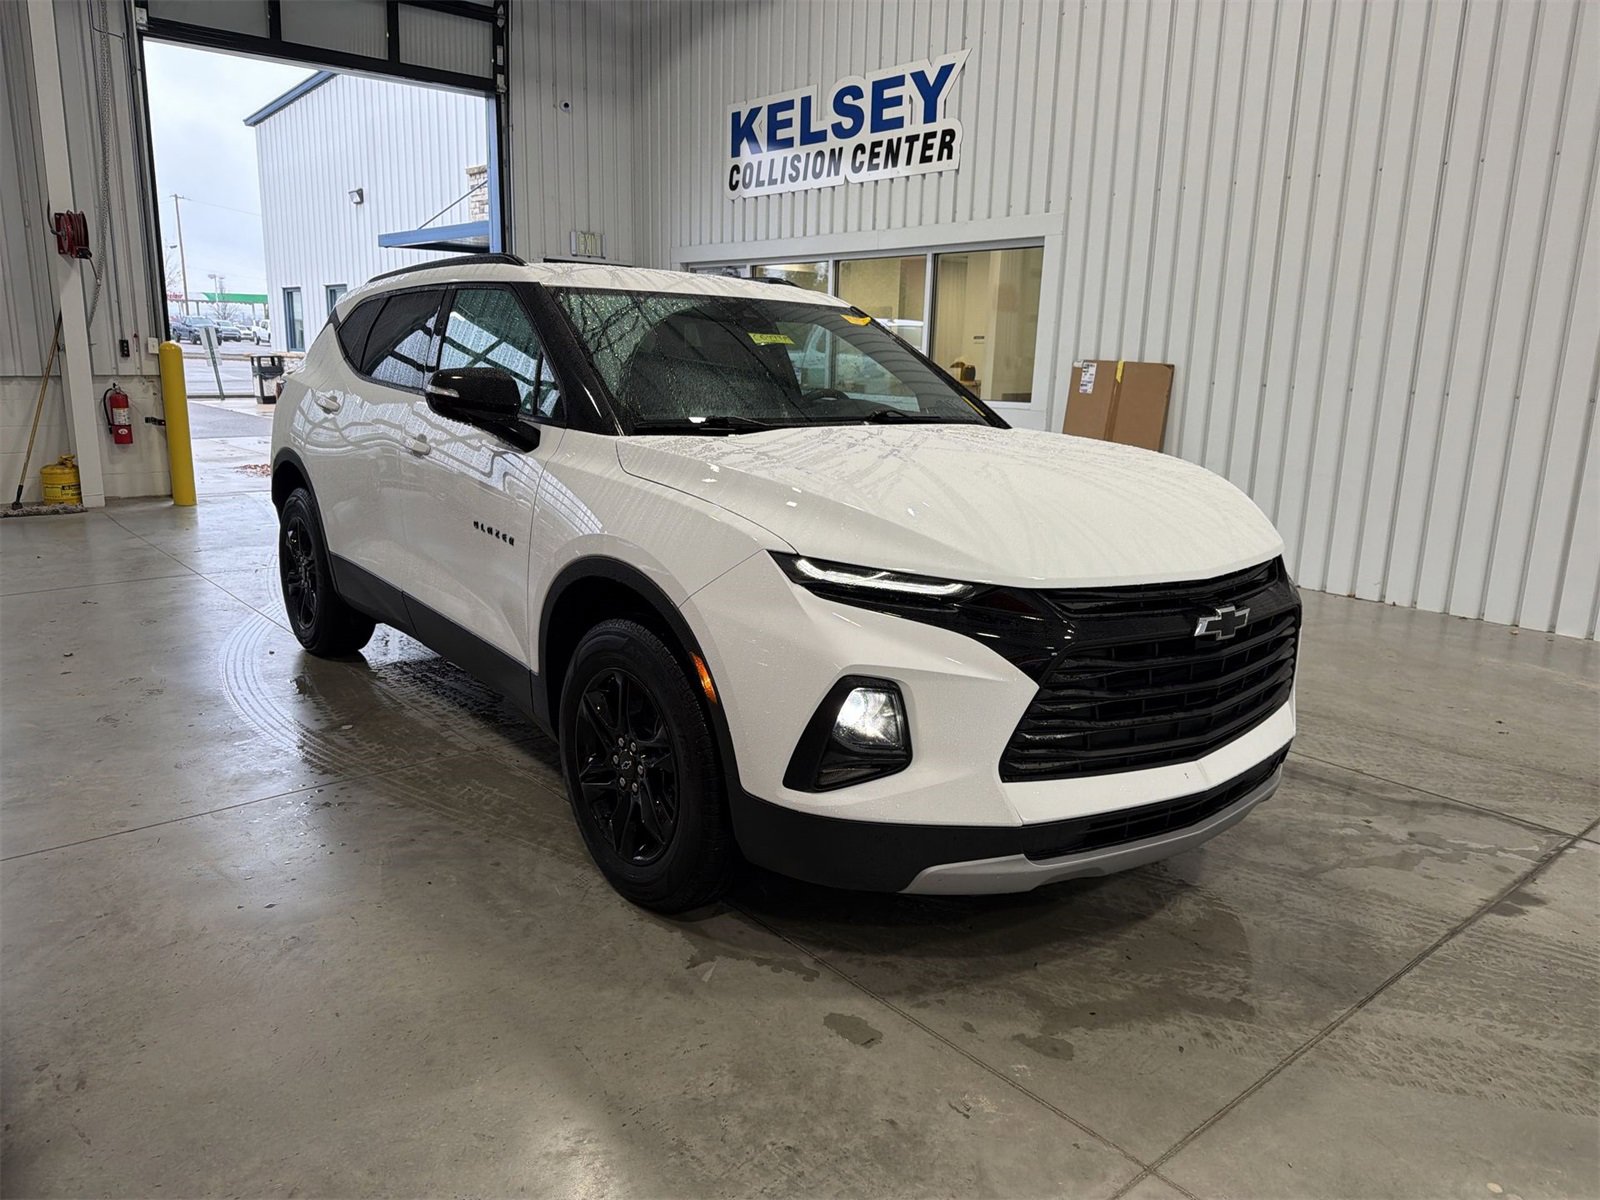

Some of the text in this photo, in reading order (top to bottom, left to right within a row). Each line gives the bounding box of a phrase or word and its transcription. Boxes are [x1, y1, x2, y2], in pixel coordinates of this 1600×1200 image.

[731, 63, 956, 158] KELSEY
[729, 128, 956, 192] COLLISION CENTER
[578, 232, 601, 256] EXIT
[473, 520, 515, 547] BLAZER
